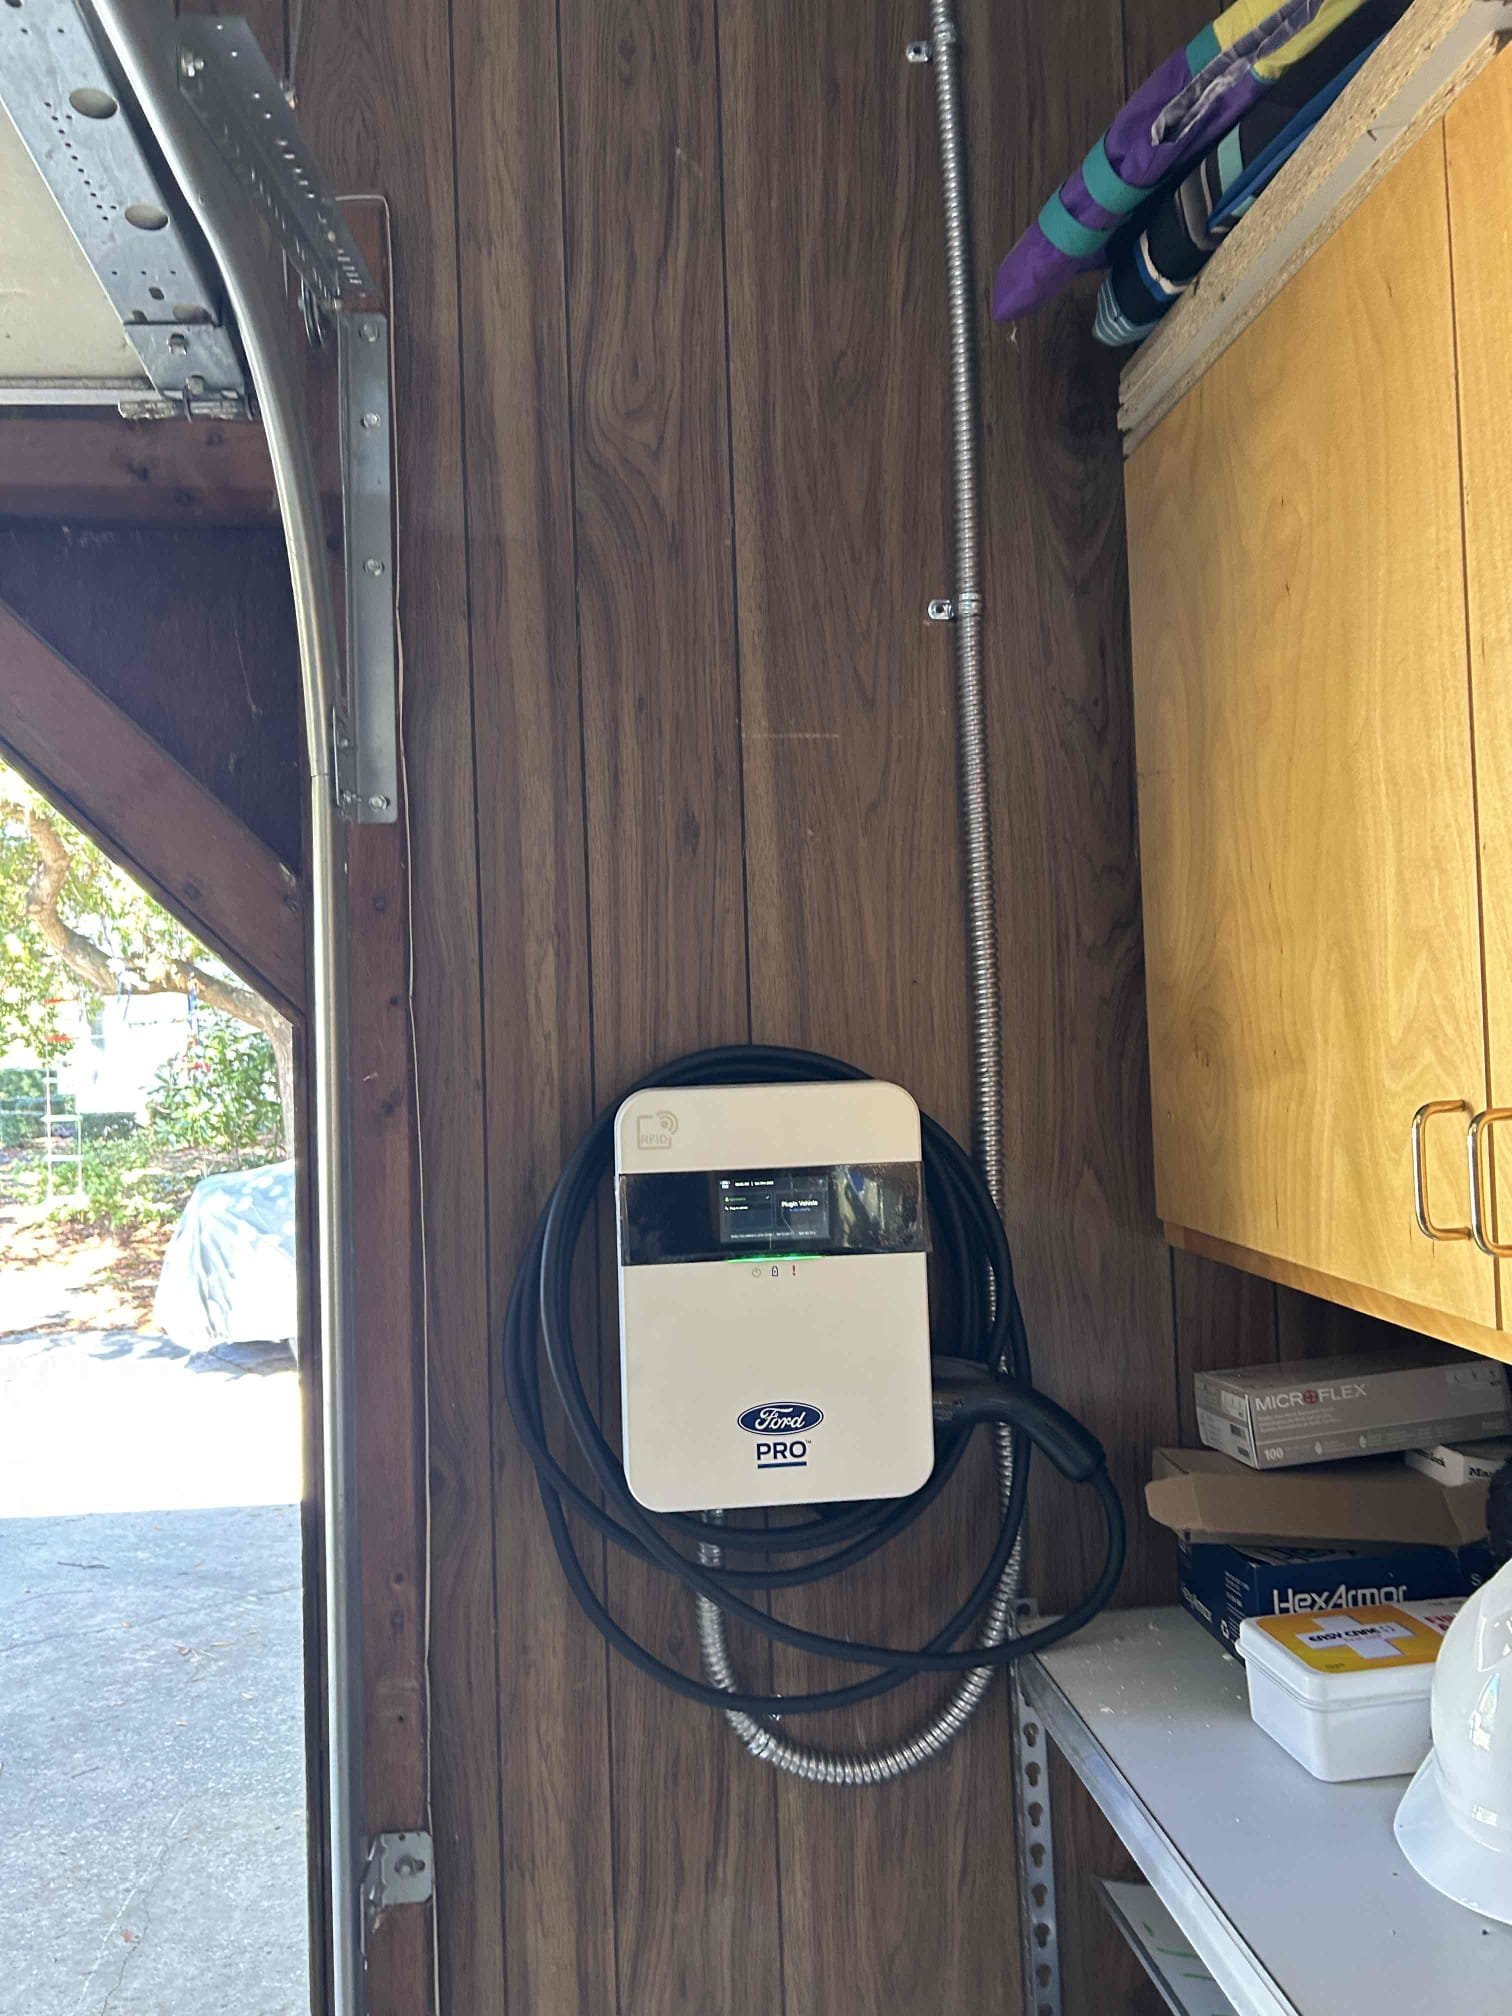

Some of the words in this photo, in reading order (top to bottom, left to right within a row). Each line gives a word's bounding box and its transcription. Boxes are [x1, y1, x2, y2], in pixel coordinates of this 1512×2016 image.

[640, 1133, 668, 1145] RFID
[1255, 1383, 1368, 1411] MICROFLEX
[755, 1407, 806, 1430] Ford
[756, 1440, 807, 1461] PRO
[1263, 1447, 1284, 1461] 100
[1273, 1584, 1407, 1615] HexArmor
